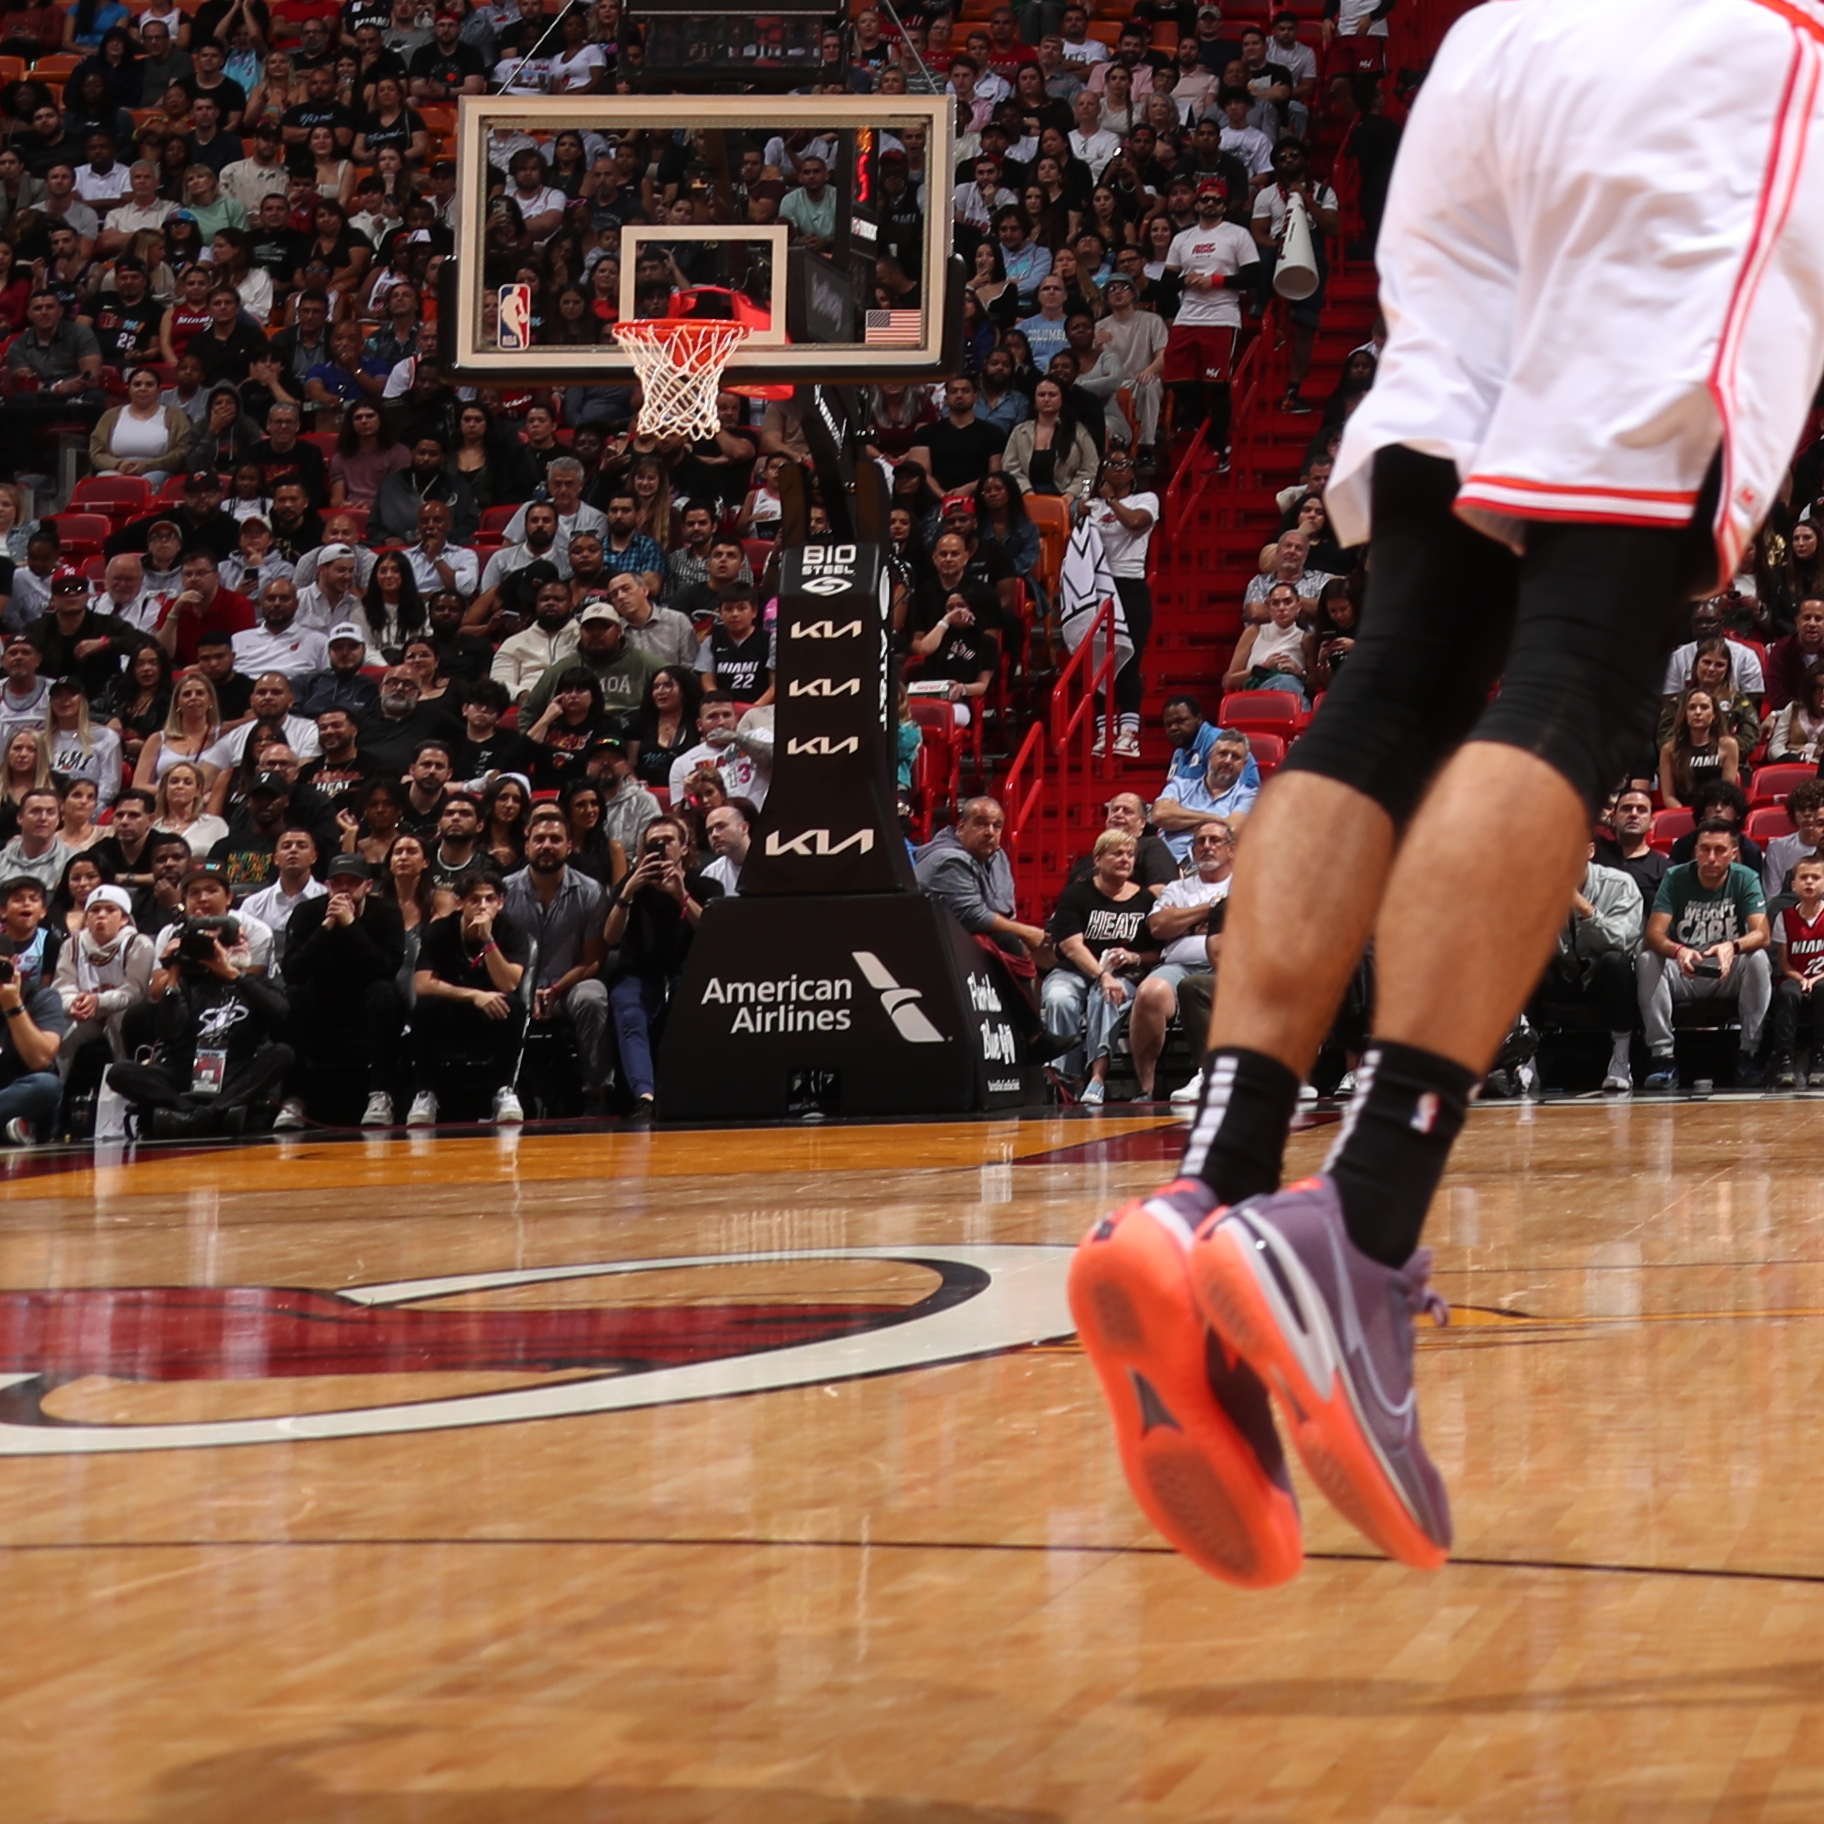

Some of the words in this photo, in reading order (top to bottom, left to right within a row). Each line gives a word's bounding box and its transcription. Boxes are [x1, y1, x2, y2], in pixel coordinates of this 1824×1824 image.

[353, 15, 390, 30] MIAMI
[116, 331, 138, 349] 22
[801, 544, 858, 566] BIO
[802, 565, 856, 576] STEEL
[716, 660, 760, 675] MIAMI
[730, 672, 756, 690] 22
[1689, 755, 1720, 768] IAMI
[315, 780, 353, 793] HEAT
[1085, 908, 1146, 943] HEAT
[1676, 916, 1741, 945] CARE
[701, 975, 853, 1006] American
[730, 1003, 852, 1033] Airlines
